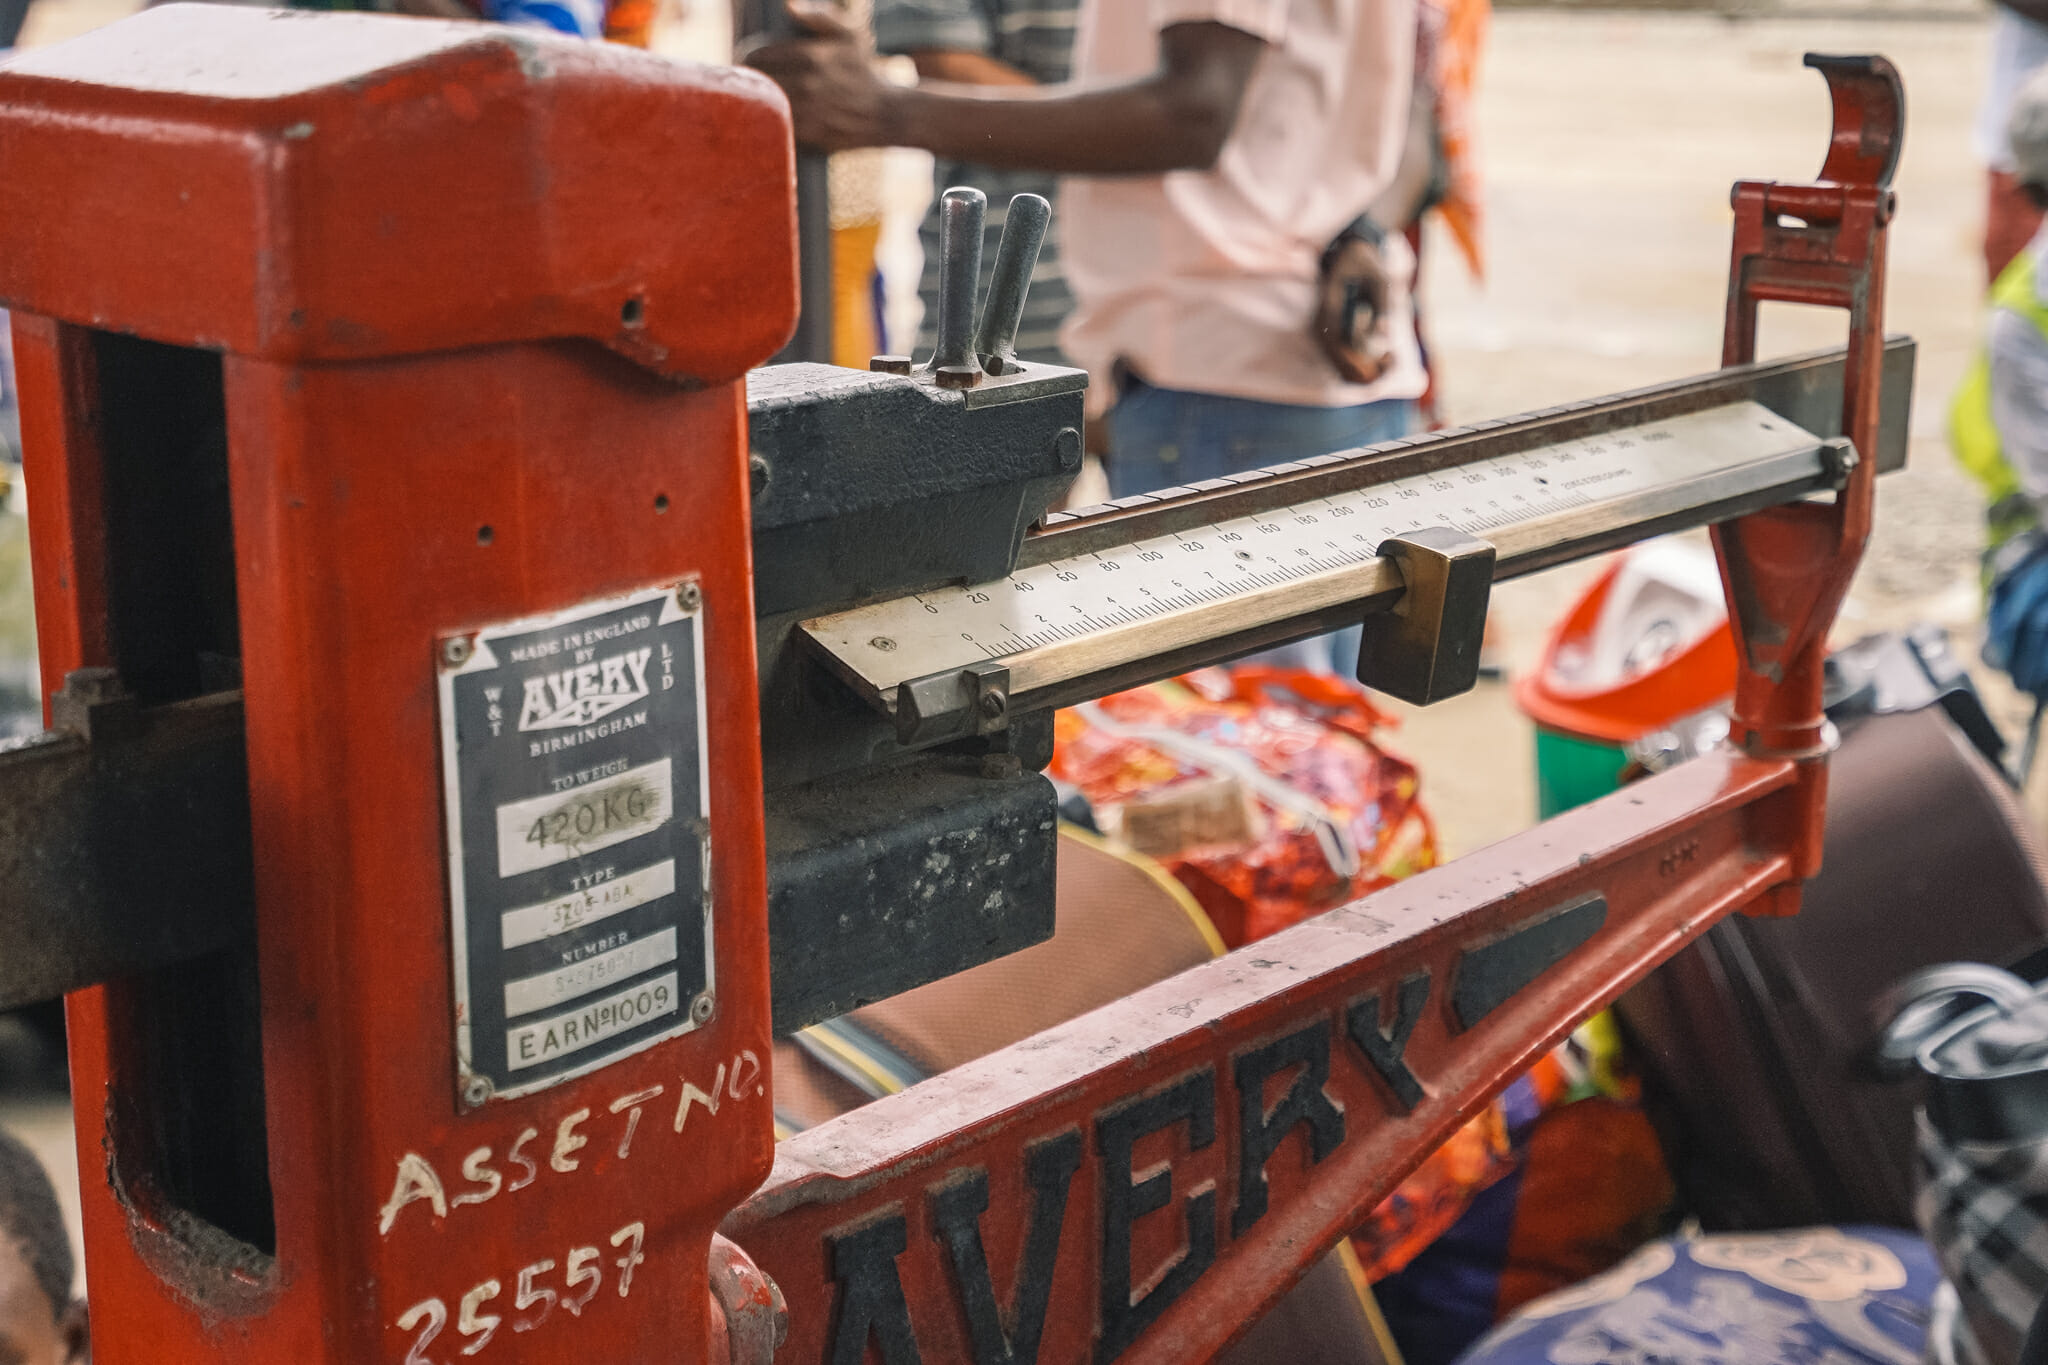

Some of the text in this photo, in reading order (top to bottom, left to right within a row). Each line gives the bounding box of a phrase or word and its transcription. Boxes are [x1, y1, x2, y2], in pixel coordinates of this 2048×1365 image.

[925, 604, 938, 614] 0
[966, 592, 990, 604] 20
[1014, 582, 1034, 592] 40
[1056, 571, 1078, 582] 60
[1099, 561, 1120, 571] 80
[1137, 551, 1163, 563] 100
[1179, 541, 1204, 553] 120
[1218, 532, 1243, 543] 140
[1256, 523, 1281, 534] 160
[1294, 515, 1319, 525] 180
[1328, 506, 1354, 518] 200
[1363, 498, 1389, 509] 220
[1396, 489, 1420, 500] 240
[1462, 474, 1487, 484] 280
[961, 633, 973, 642] 0
[1034, 614, 1048, 623] 2
[1070, 605, 1082, 614] 3
[1106, 596, 1116, 605] 4
[1139, 587, 1151, 595] 5
[1171, 579, 1183, 588] 6
[1203, 571, 1214, 580] 7
[1235, 564, 1246, 572] 8
[1266, 556, 1277, 564] 9
[1294, 548, 1310, 557] 10
[1325, 541, 1338, 549] 11
[1353, 534, 1367, 542] 12
[1381, 527, 1396, 535] 13
[1409, 520, 1422, 528] 14
[1435, 513, 1449, 521] 15
[511, 616, 650, 663] MADE IN ENGLAND
[575, 648, 595, 664] BY
[661, 643, 675, 691] LTD
[519, 649, 652, 731] AVERY
[529, 710, 647, 757] BIRMINGHAM
[552, 757, 629, 792] TO WEIGH
[526, 787, 646, 849] 420KG
[571, 866, 616, 891] TYPE
[562, 932, 628, 965] NUMBER
[379, 1084, 664, 1236] ASSET
[822, 970, 1431, 1365] AVERY
[397, 1222, 645, 1365] 25557
